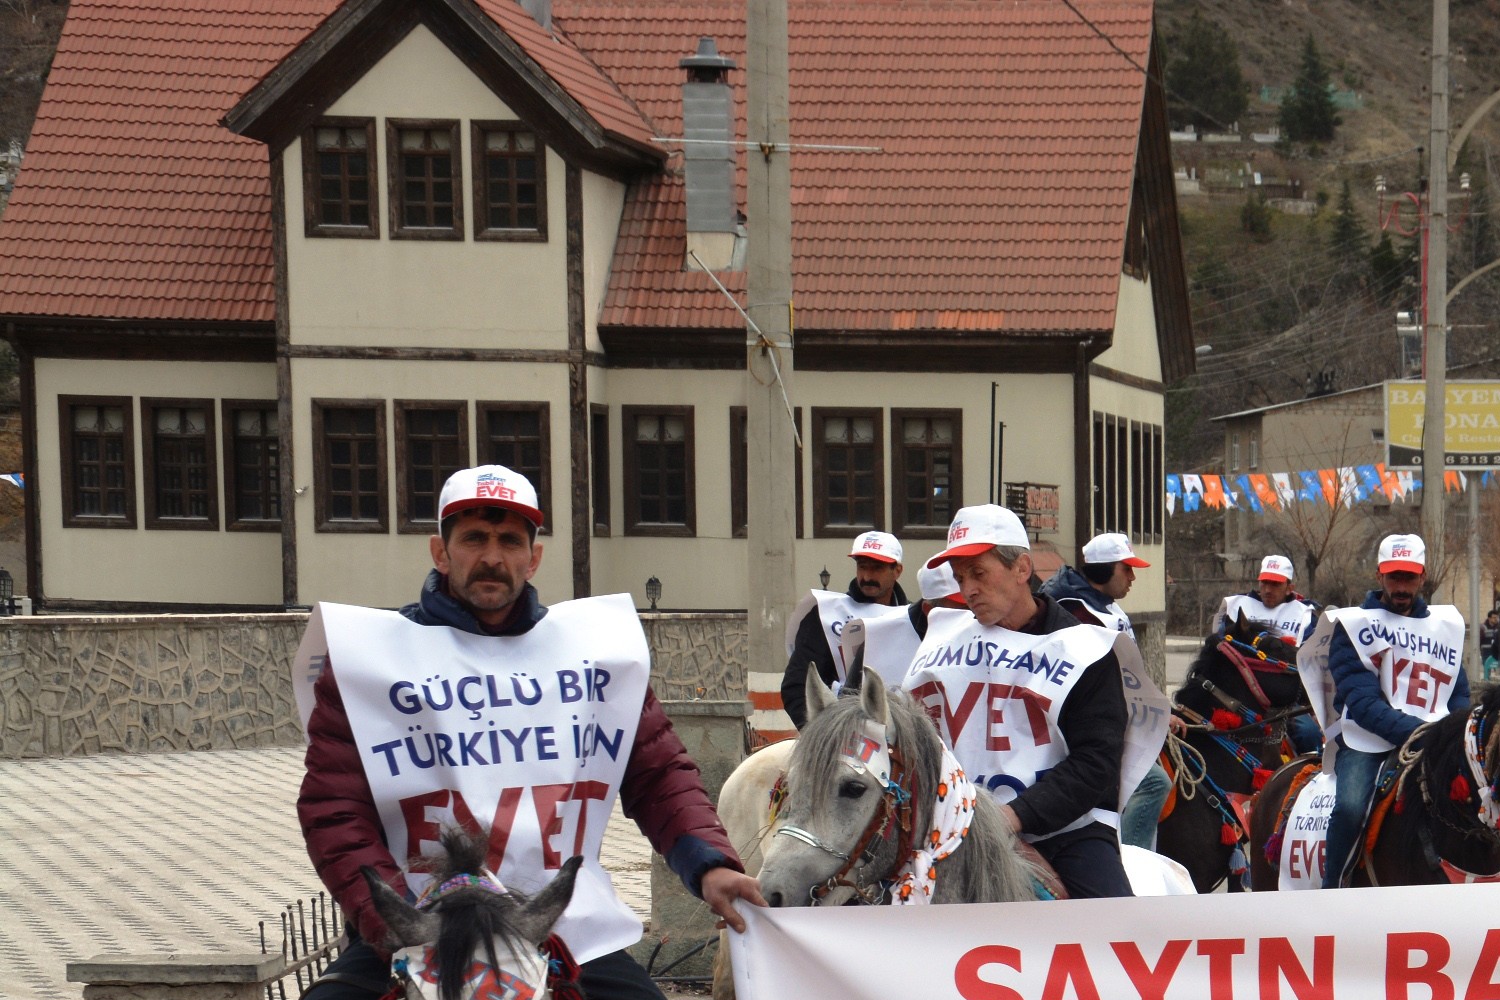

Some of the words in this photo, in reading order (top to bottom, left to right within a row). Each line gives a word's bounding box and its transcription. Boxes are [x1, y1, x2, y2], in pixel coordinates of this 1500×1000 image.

[1459, 455, 1488, 465] 213
[476, 485, 517, 500] EVET
[862, 542, 883, 550] EVET
[1391, 550, 1412, 558] EVET
[911, 635, 1075, 686] GÜMÜŞHANE
[1358, 619, 1457, 667] GÜMÜŞHANE
[389, 672, 543, 721] GÜÇLÜ
[557, 660, 612, 704] BİR
[371, 720, 559, 777] TÜRKİYE
[573, 711, 625, 768] İÇİN
[397, 780, 611, 876] EVET
[1289, 840, 1327, 880] EVE
